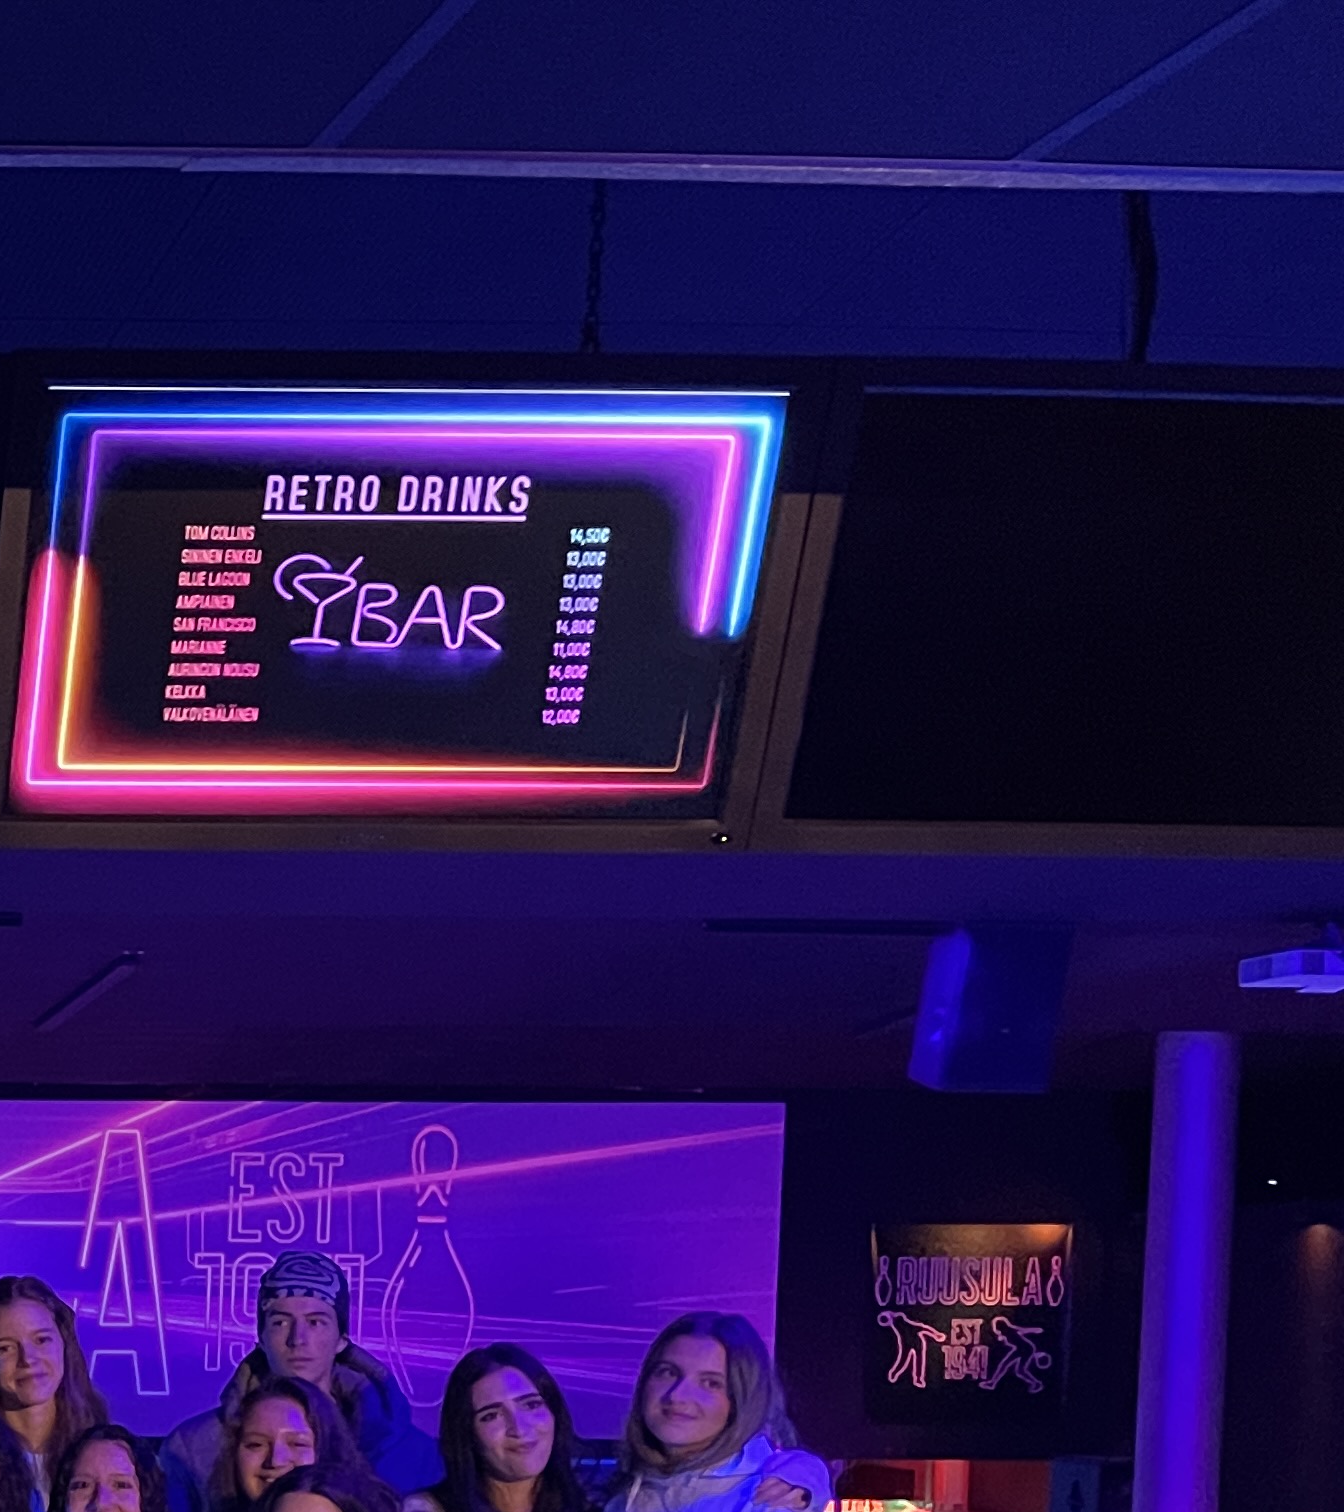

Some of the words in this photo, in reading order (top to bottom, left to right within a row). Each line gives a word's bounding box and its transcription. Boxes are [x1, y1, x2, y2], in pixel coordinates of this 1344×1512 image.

[263, 475, 381, 511] RETRO
[397, 475, 531, 513] DRINKS
[351, 583, 505, 651] BAR
[228, 1152, 344, 1243] EST
[895, 1256, 1043, 1306] RUUSULA
[950, 1318, 984, 1346] EST
[941, 1345, 990, 1380] 1941
